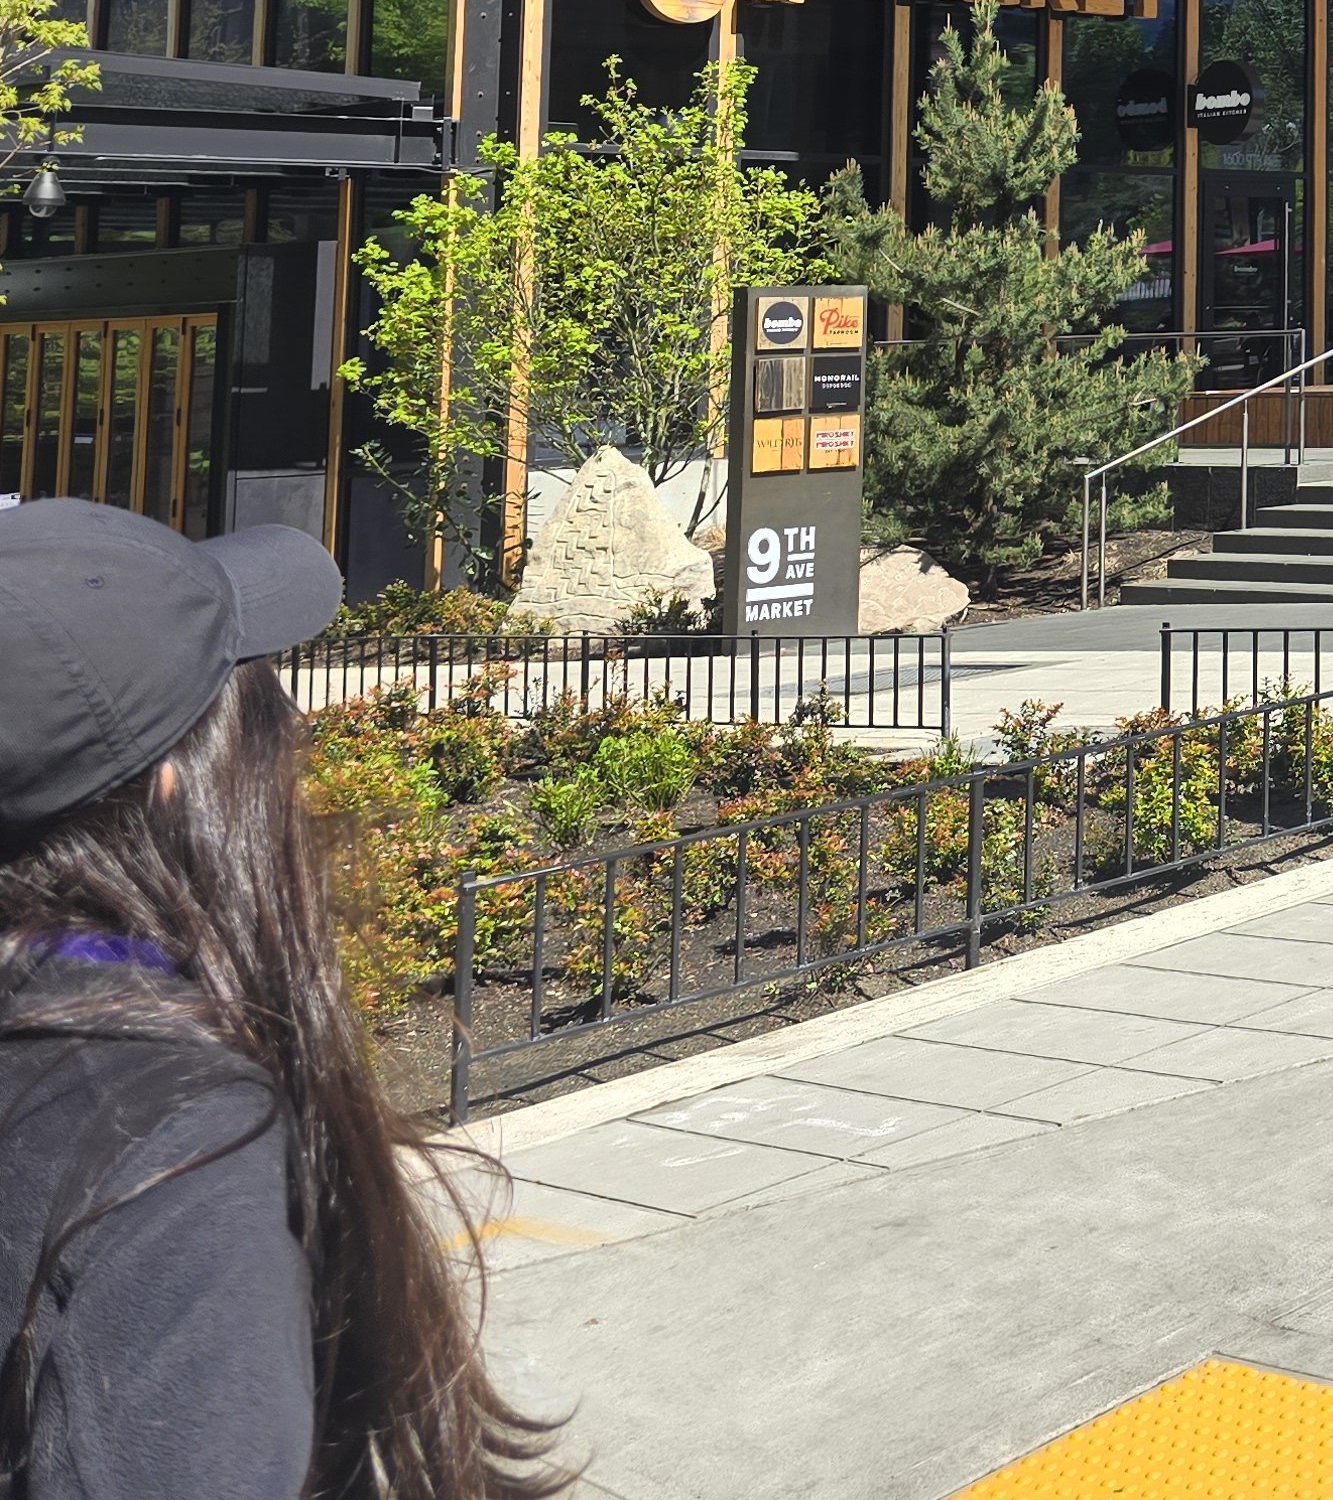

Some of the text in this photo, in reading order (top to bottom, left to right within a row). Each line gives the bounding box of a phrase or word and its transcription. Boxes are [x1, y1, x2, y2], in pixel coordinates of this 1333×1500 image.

[1194, 89, 1251, 111] bombo
[819, 307, 859, 336] Pike
[814, 373, 860, 383] MONORAIL
[785, 562, 815, 580] AVE
[745, 598, 813, 622] MARKET
